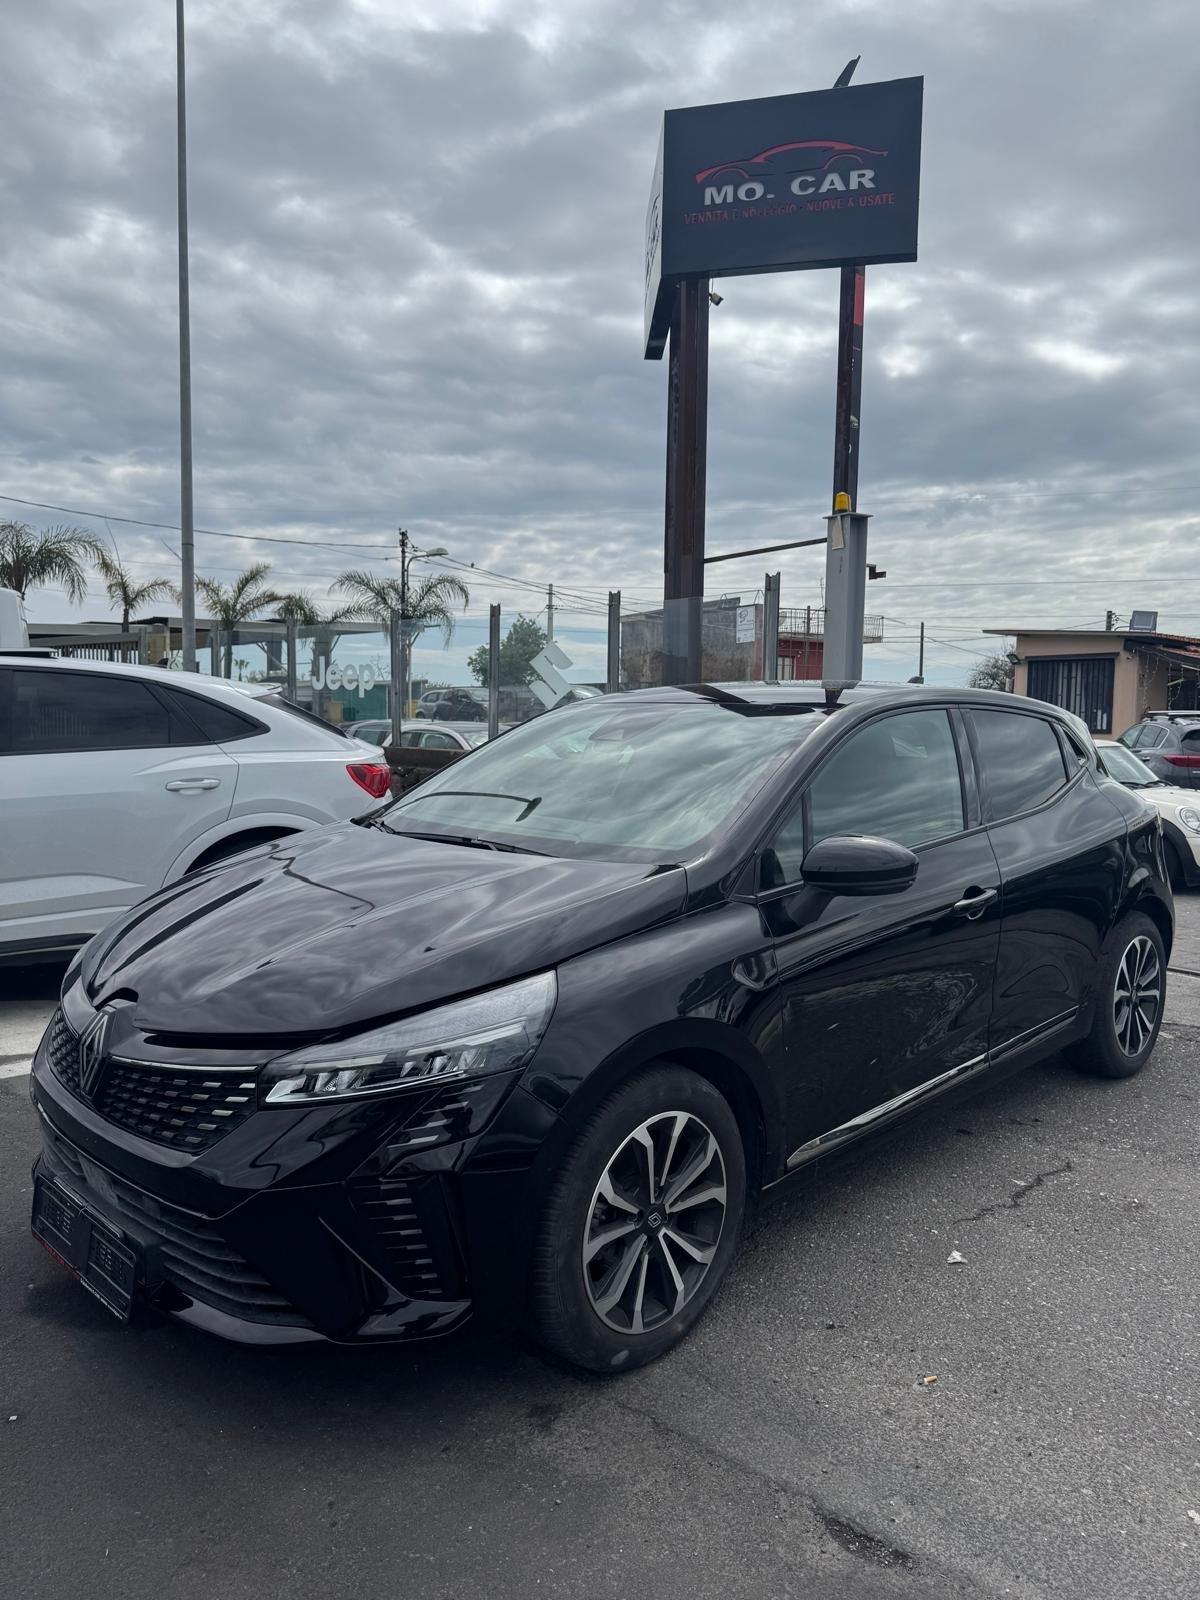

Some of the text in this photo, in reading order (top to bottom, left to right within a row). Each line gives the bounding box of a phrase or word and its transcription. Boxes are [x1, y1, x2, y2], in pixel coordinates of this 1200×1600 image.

[704, 169, 877, 206] MO. CAR
[806, 198, 844, 212] NUOVE
[847, 197, 855, 208] &
[859, 192, 896, 207] USATE
[311, 655, 376, 698] Jeep
